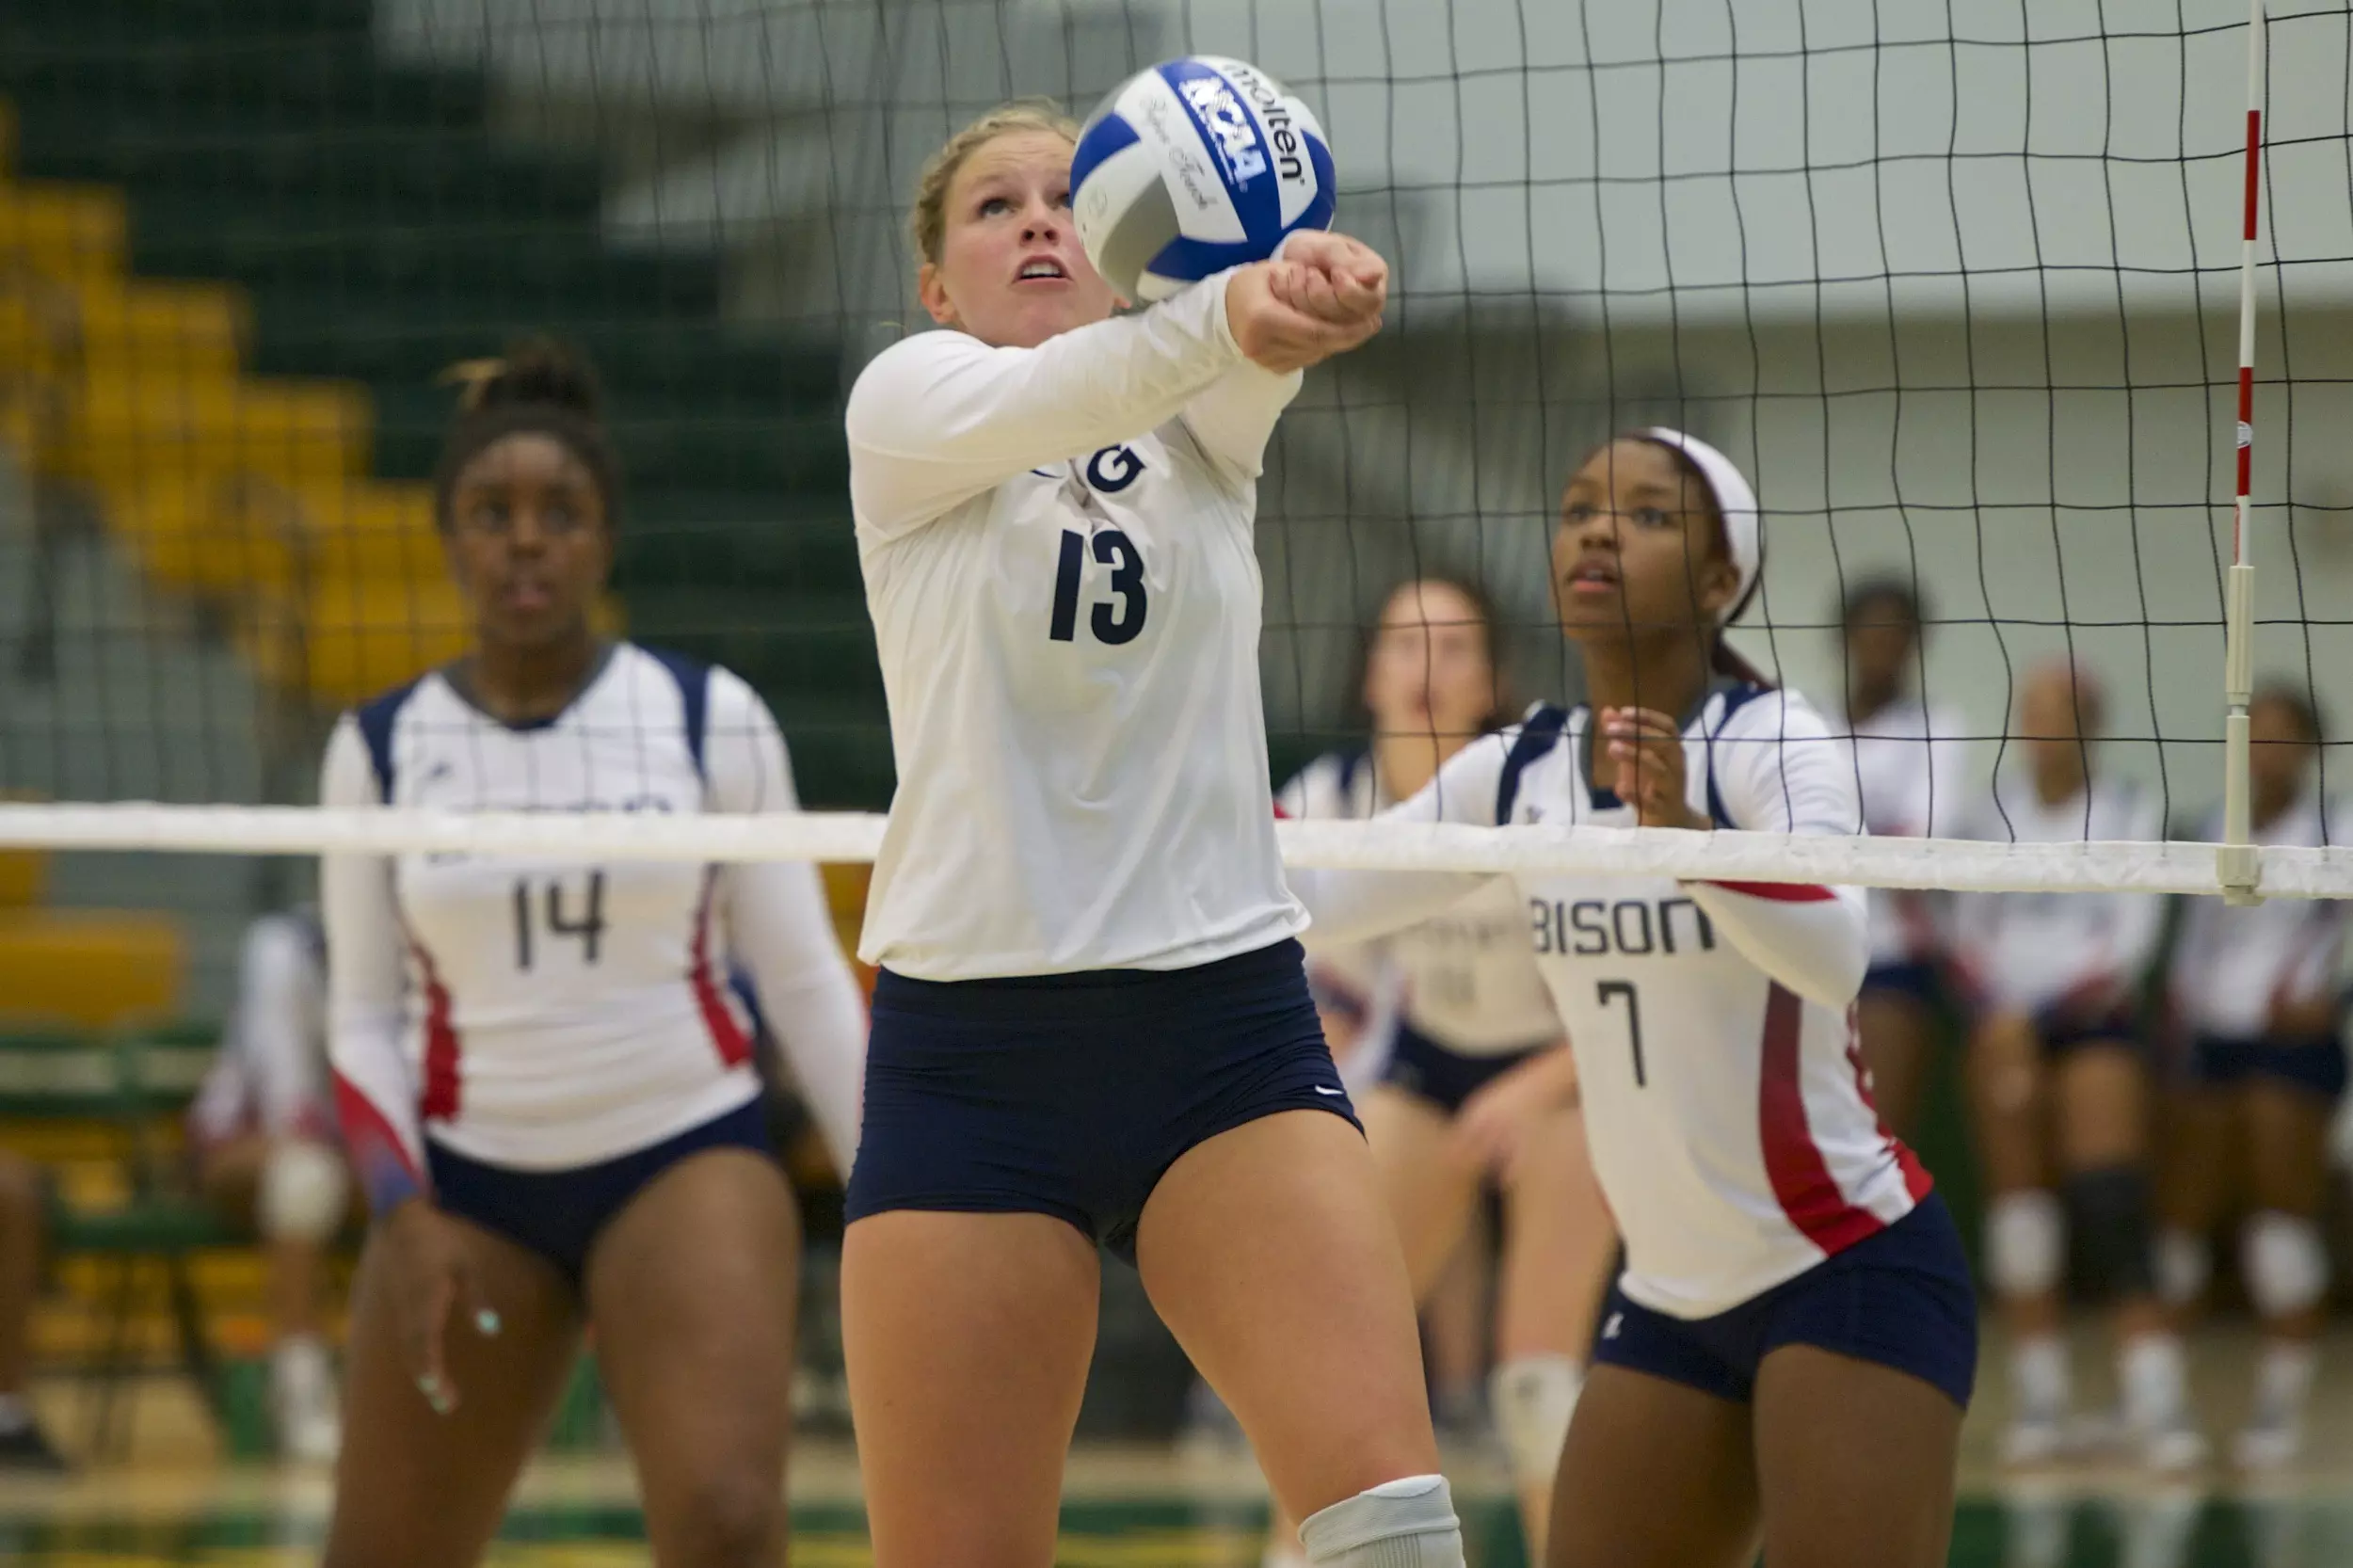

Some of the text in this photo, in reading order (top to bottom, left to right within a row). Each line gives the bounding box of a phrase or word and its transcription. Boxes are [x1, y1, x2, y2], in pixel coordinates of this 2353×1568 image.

[1049, 528, 1147, 645] 13
[514, 868, 607, 970] 14
[1530, 898, 1715, 955] BISON
[1596, 980, 1646, 1088] 7
